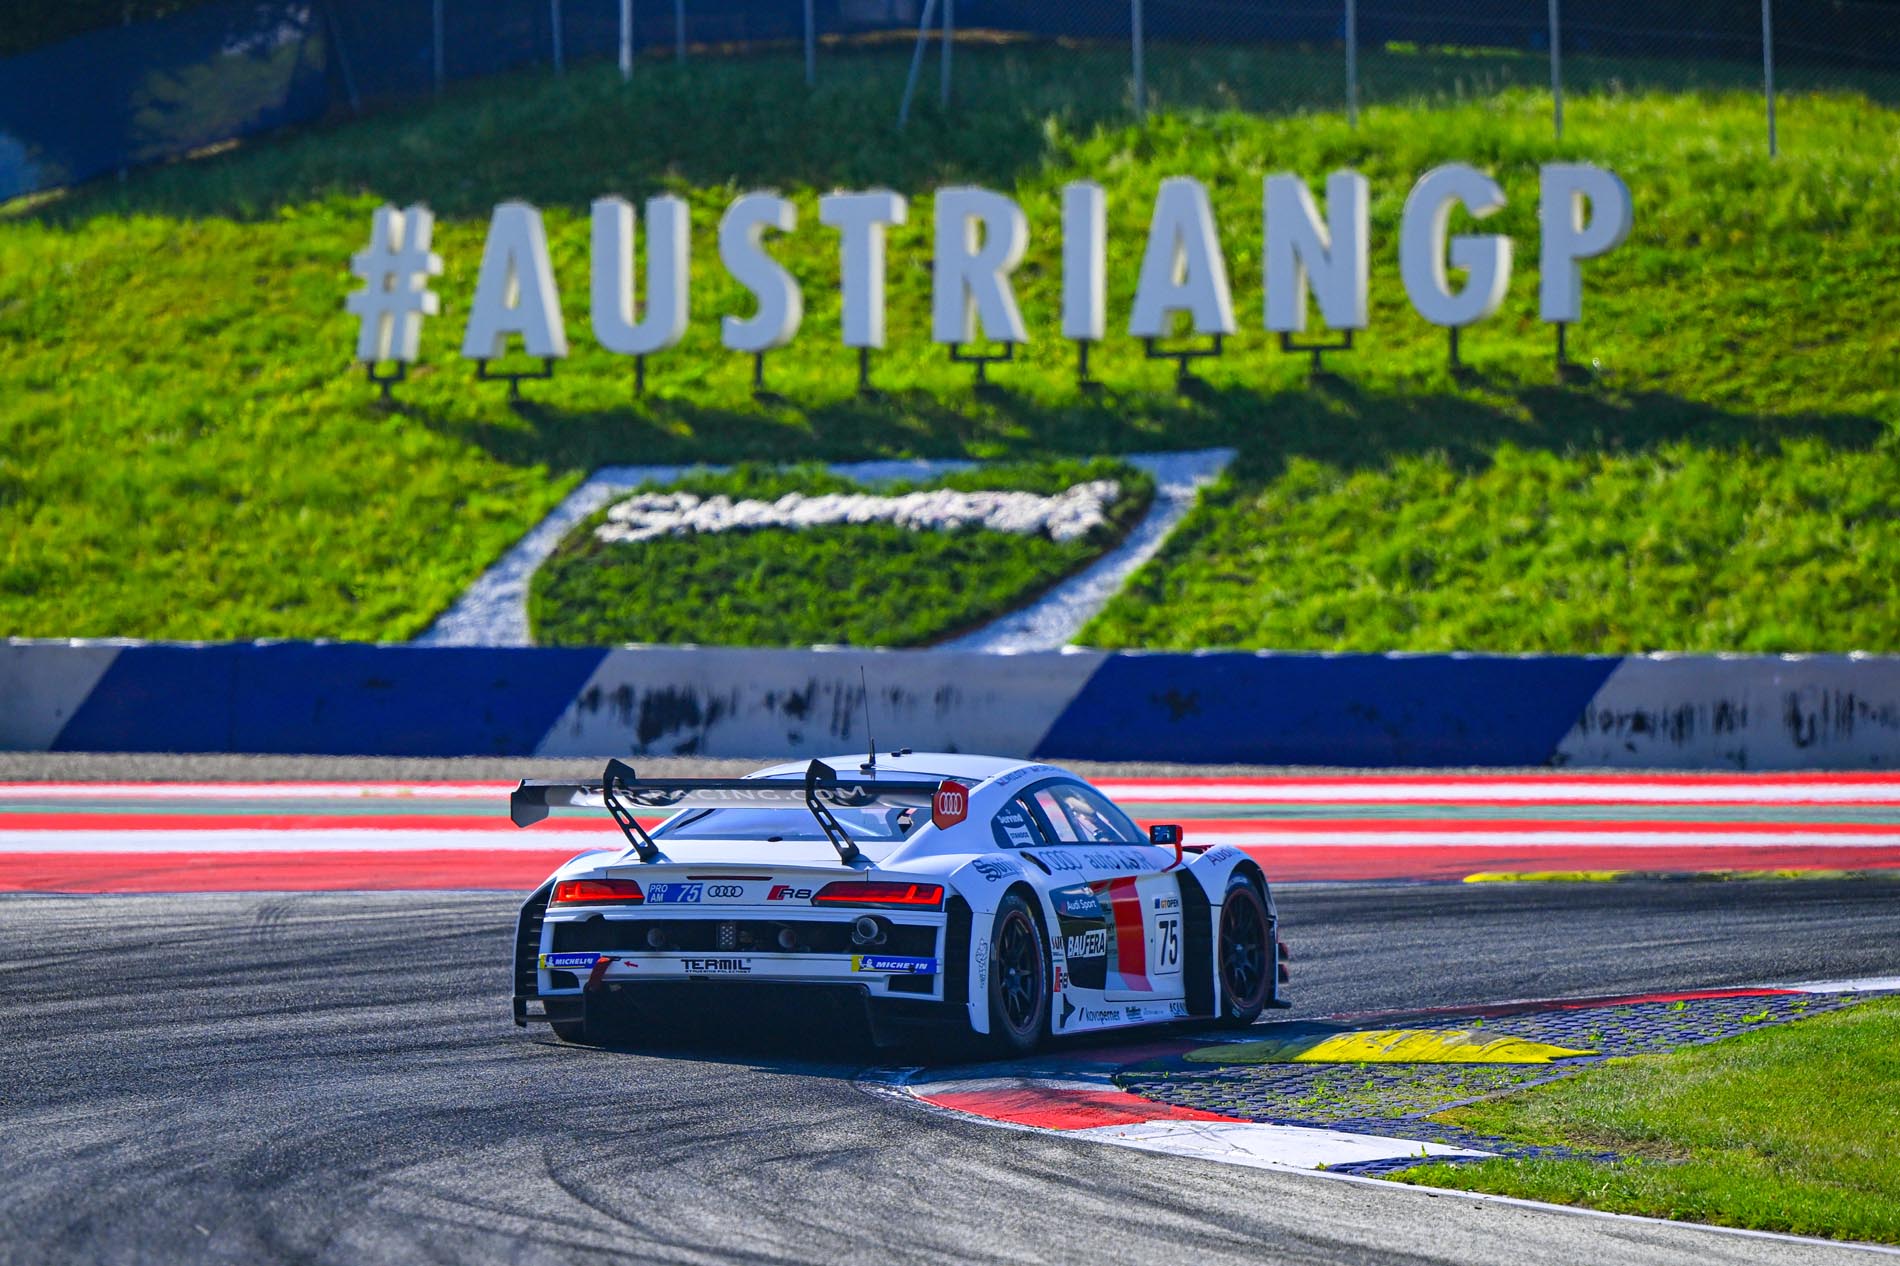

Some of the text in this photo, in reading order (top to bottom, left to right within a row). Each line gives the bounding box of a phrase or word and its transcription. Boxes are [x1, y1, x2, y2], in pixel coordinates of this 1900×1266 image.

[347, 160, 1632, 362] #AUSTRIANGP
[650, 884, 700, 902] PRO 75
[650, 893, 664, 902] AM
[776, 889, 812, 899] R8
[1066, 899, 1097, 912] Audi Sport
[1067, 931, 1105, 956] BAUFERA
[1158, 920, 1178, 967] 75
[554, 957, 593, 966] MICHELIN
[680, 958, 751, 970] TERMIL
